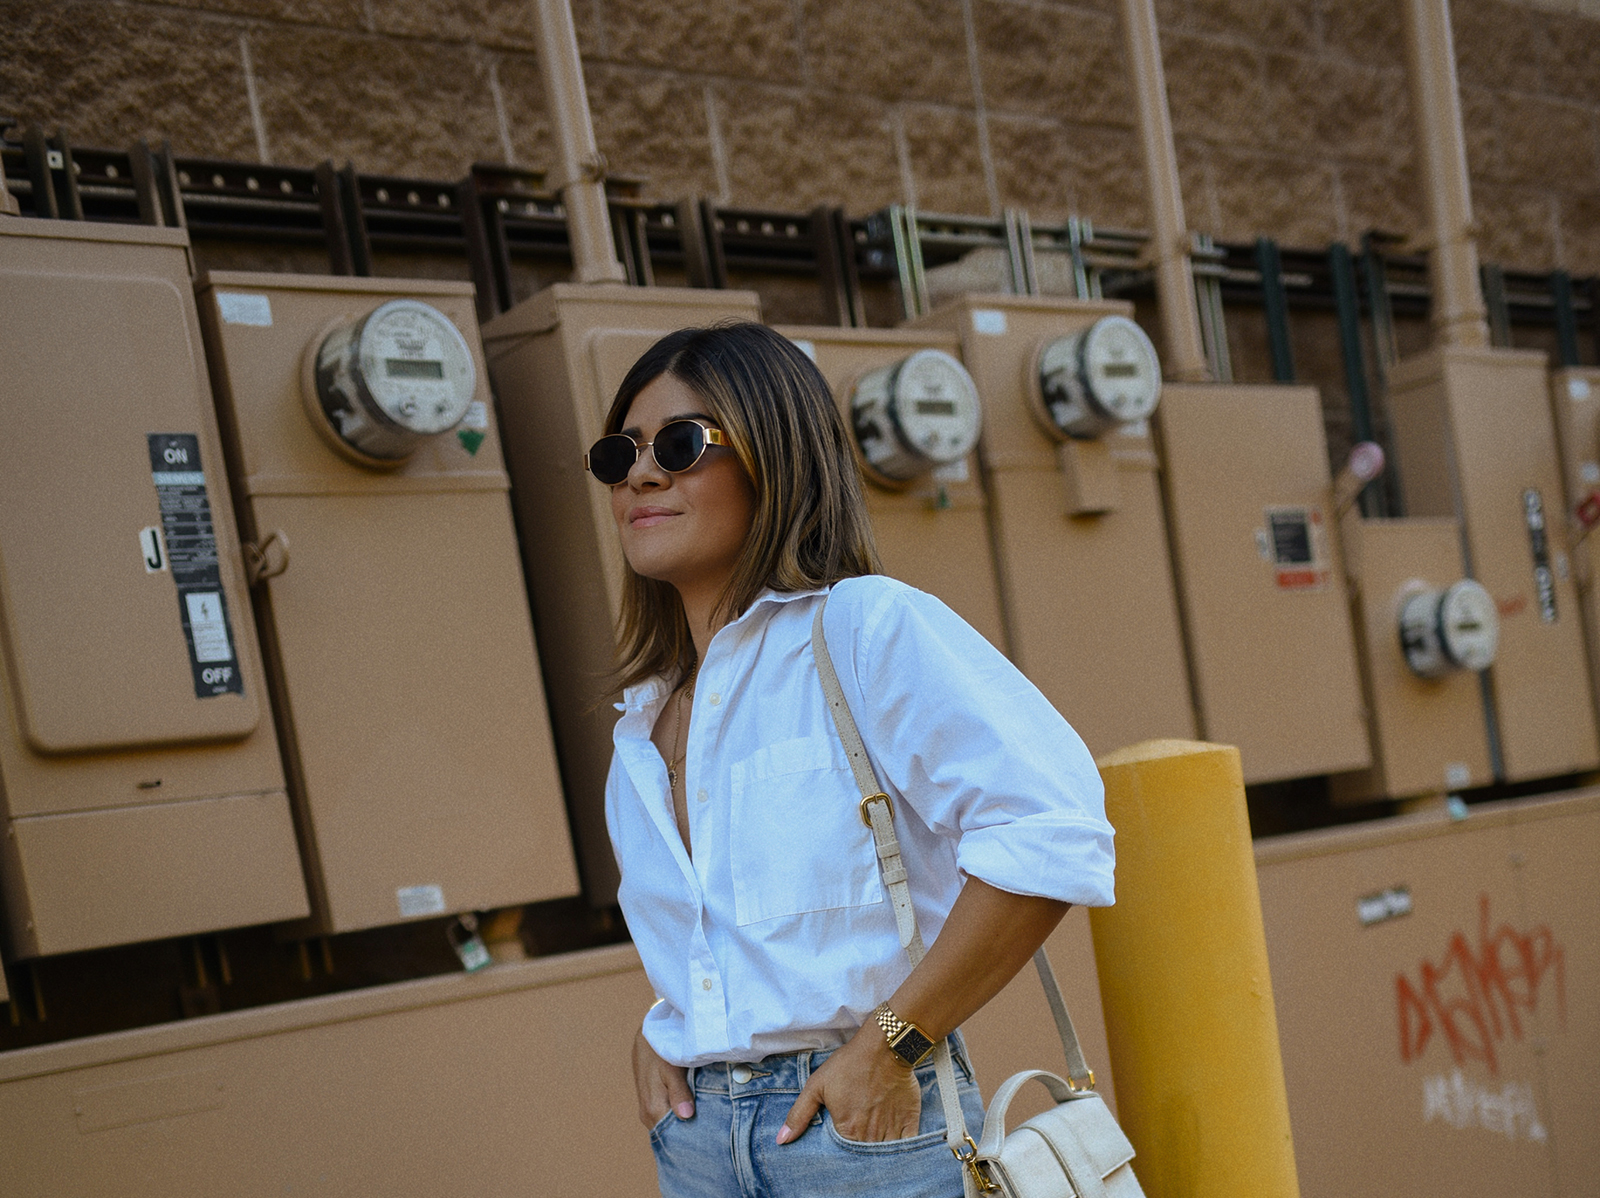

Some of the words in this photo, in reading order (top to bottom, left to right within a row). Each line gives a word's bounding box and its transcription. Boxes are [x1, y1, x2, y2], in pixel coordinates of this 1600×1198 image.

[164, 448, 188, 464] ON
[147, 530, 162, 570] J
[202, 667, 233, 684] OFF
